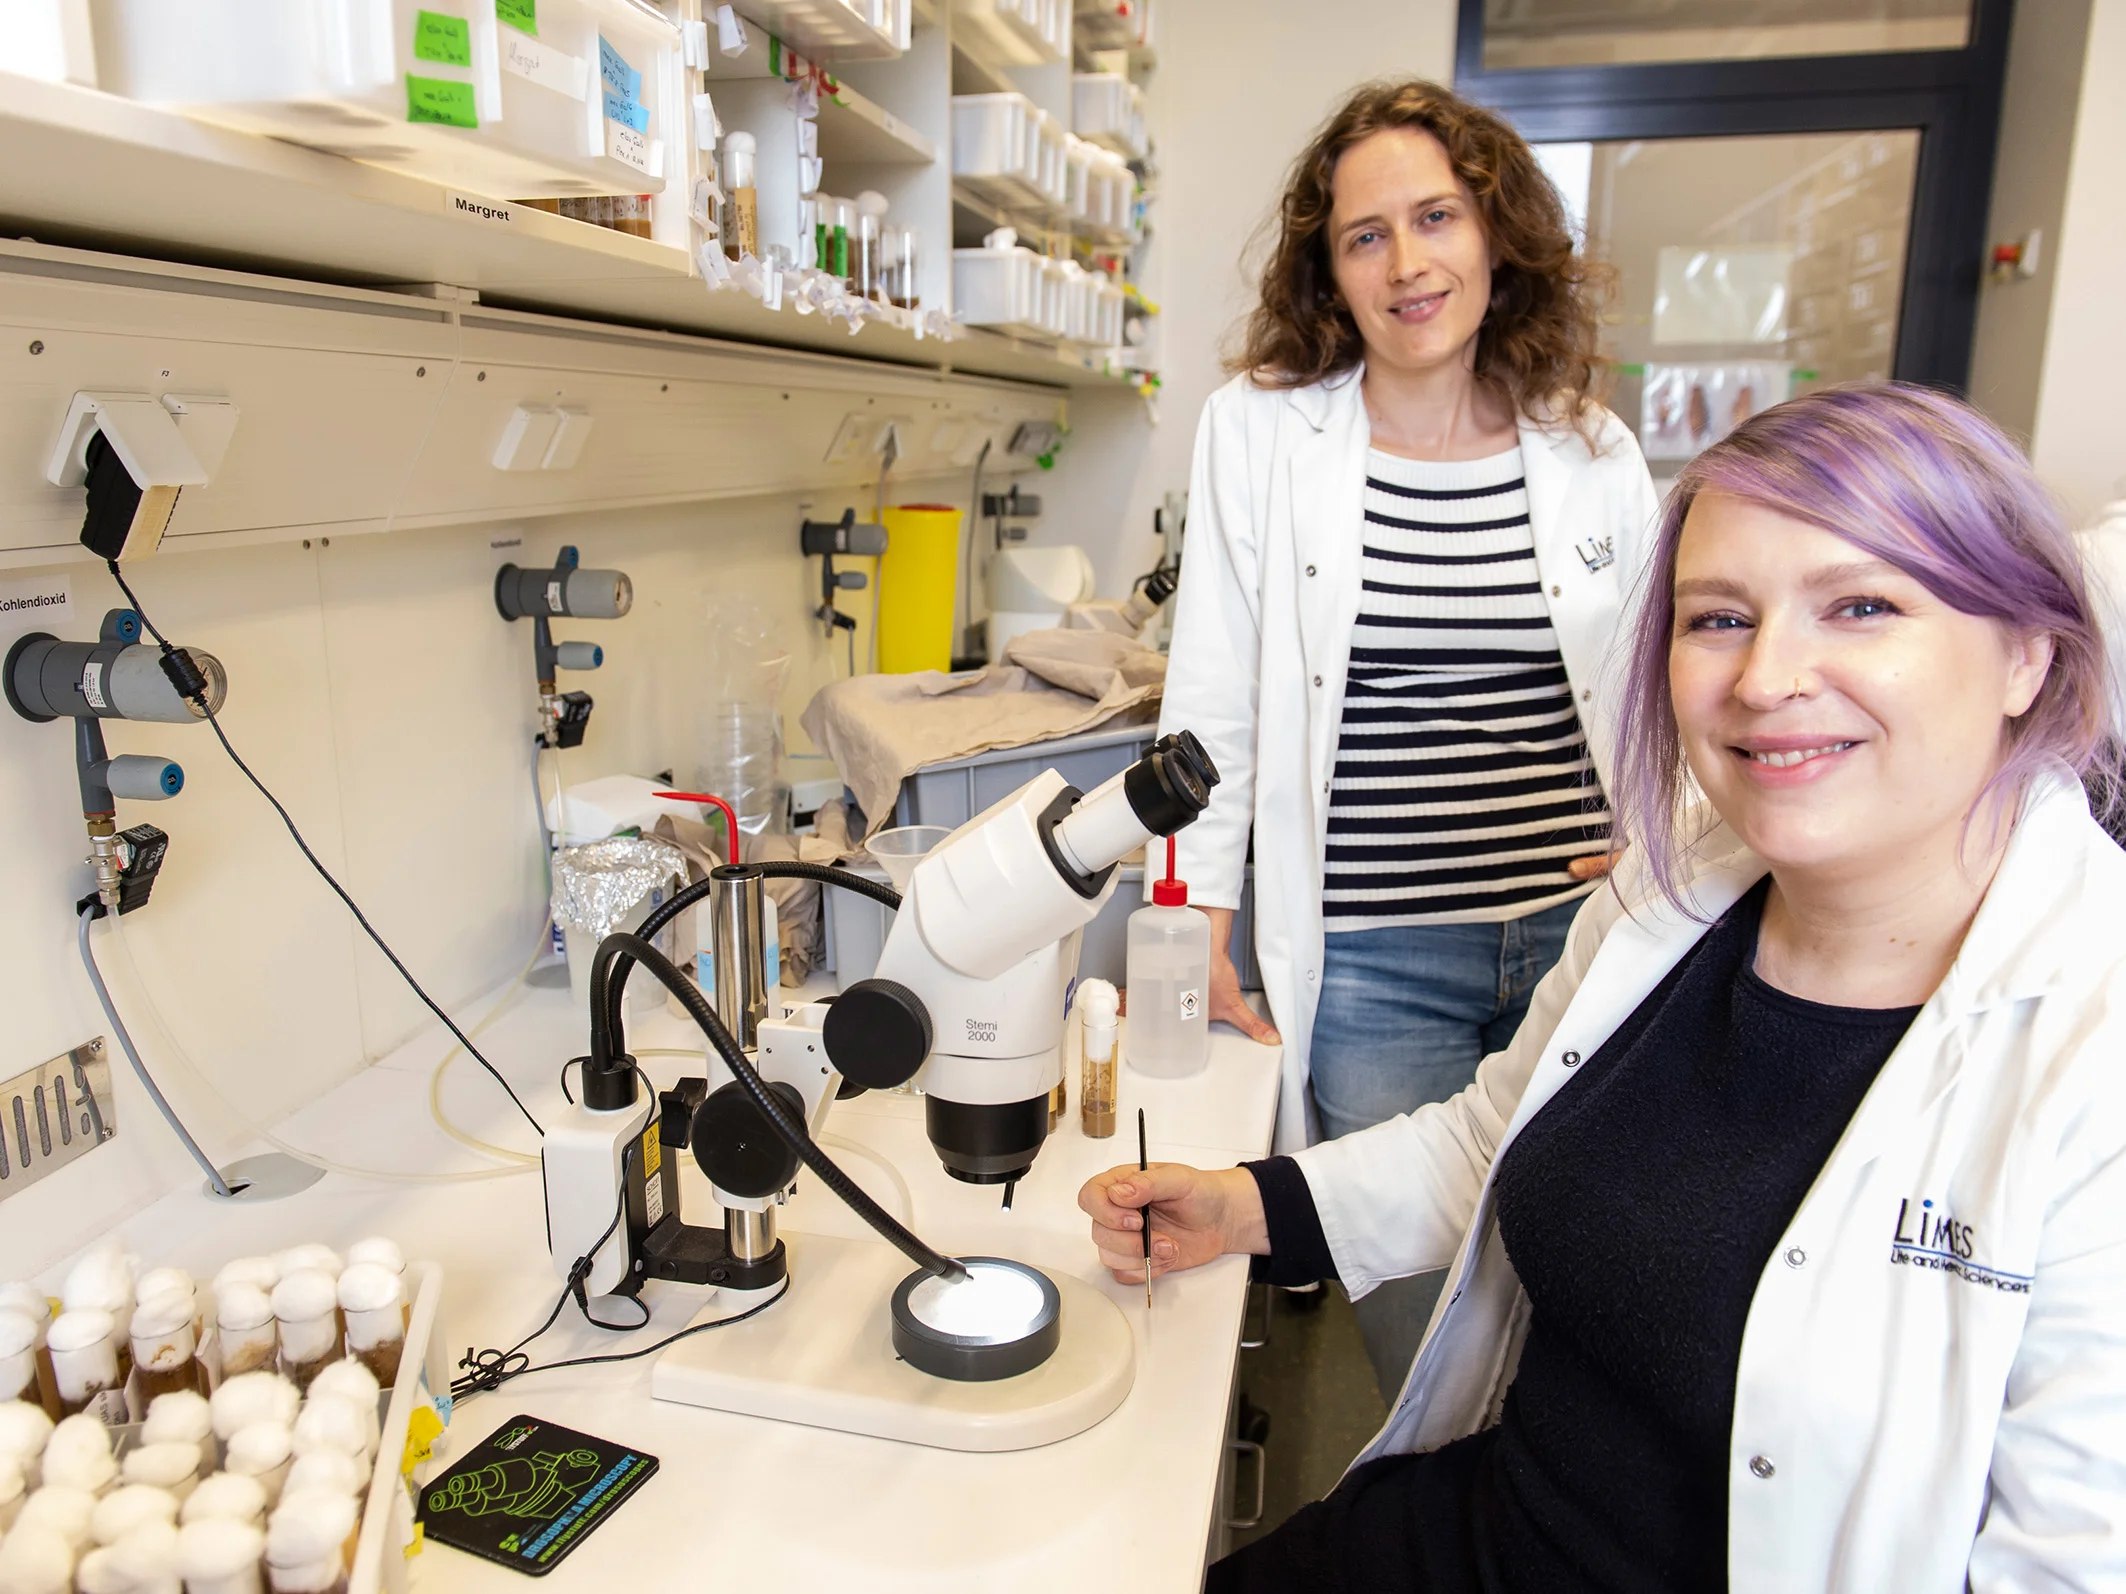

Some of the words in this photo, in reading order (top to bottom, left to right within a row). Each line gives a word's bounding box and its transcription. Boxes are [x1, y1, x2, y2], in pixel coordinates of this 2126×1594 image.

[455, 197, 510, 222] Margret
[966, 1018, 998, 1031] Stemi
[968, 1030, 996, 1043] 2000
[577, 1453, 638, 1507] MICROSCOPY
